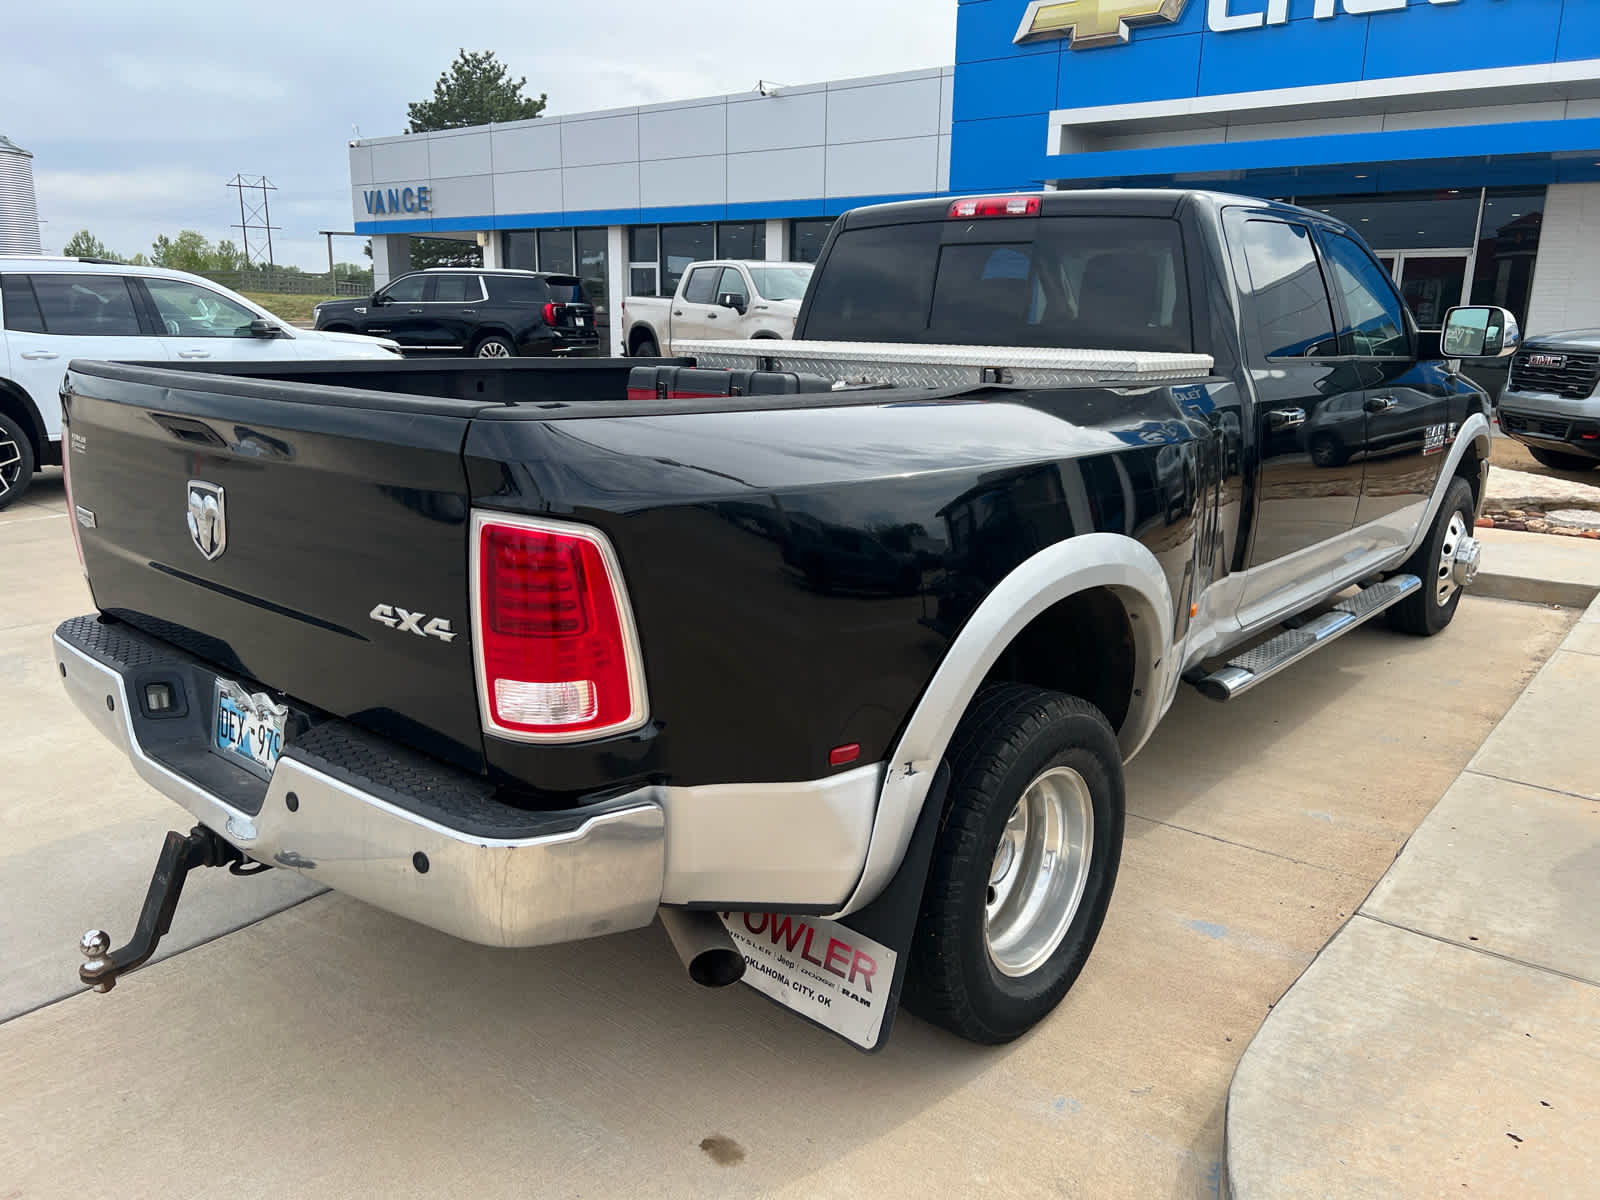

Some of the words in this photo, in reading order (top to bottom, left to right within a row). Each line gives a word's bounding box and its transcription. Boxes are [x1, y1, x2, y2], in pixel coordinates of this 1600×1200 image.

[363, 186, 431, 214] VANCE
[1528, 354, 1562, 367] GMC
[369, 603, 458, 642] 4X4
[723, 911, 878, 993] OWLER
[744, 955, 790, 987] OKLAHOMA
[817, 994, 832, 1008] OK
[777, 954, 795, 969] Jeep
[841, 987, 871, 1008] RAM
